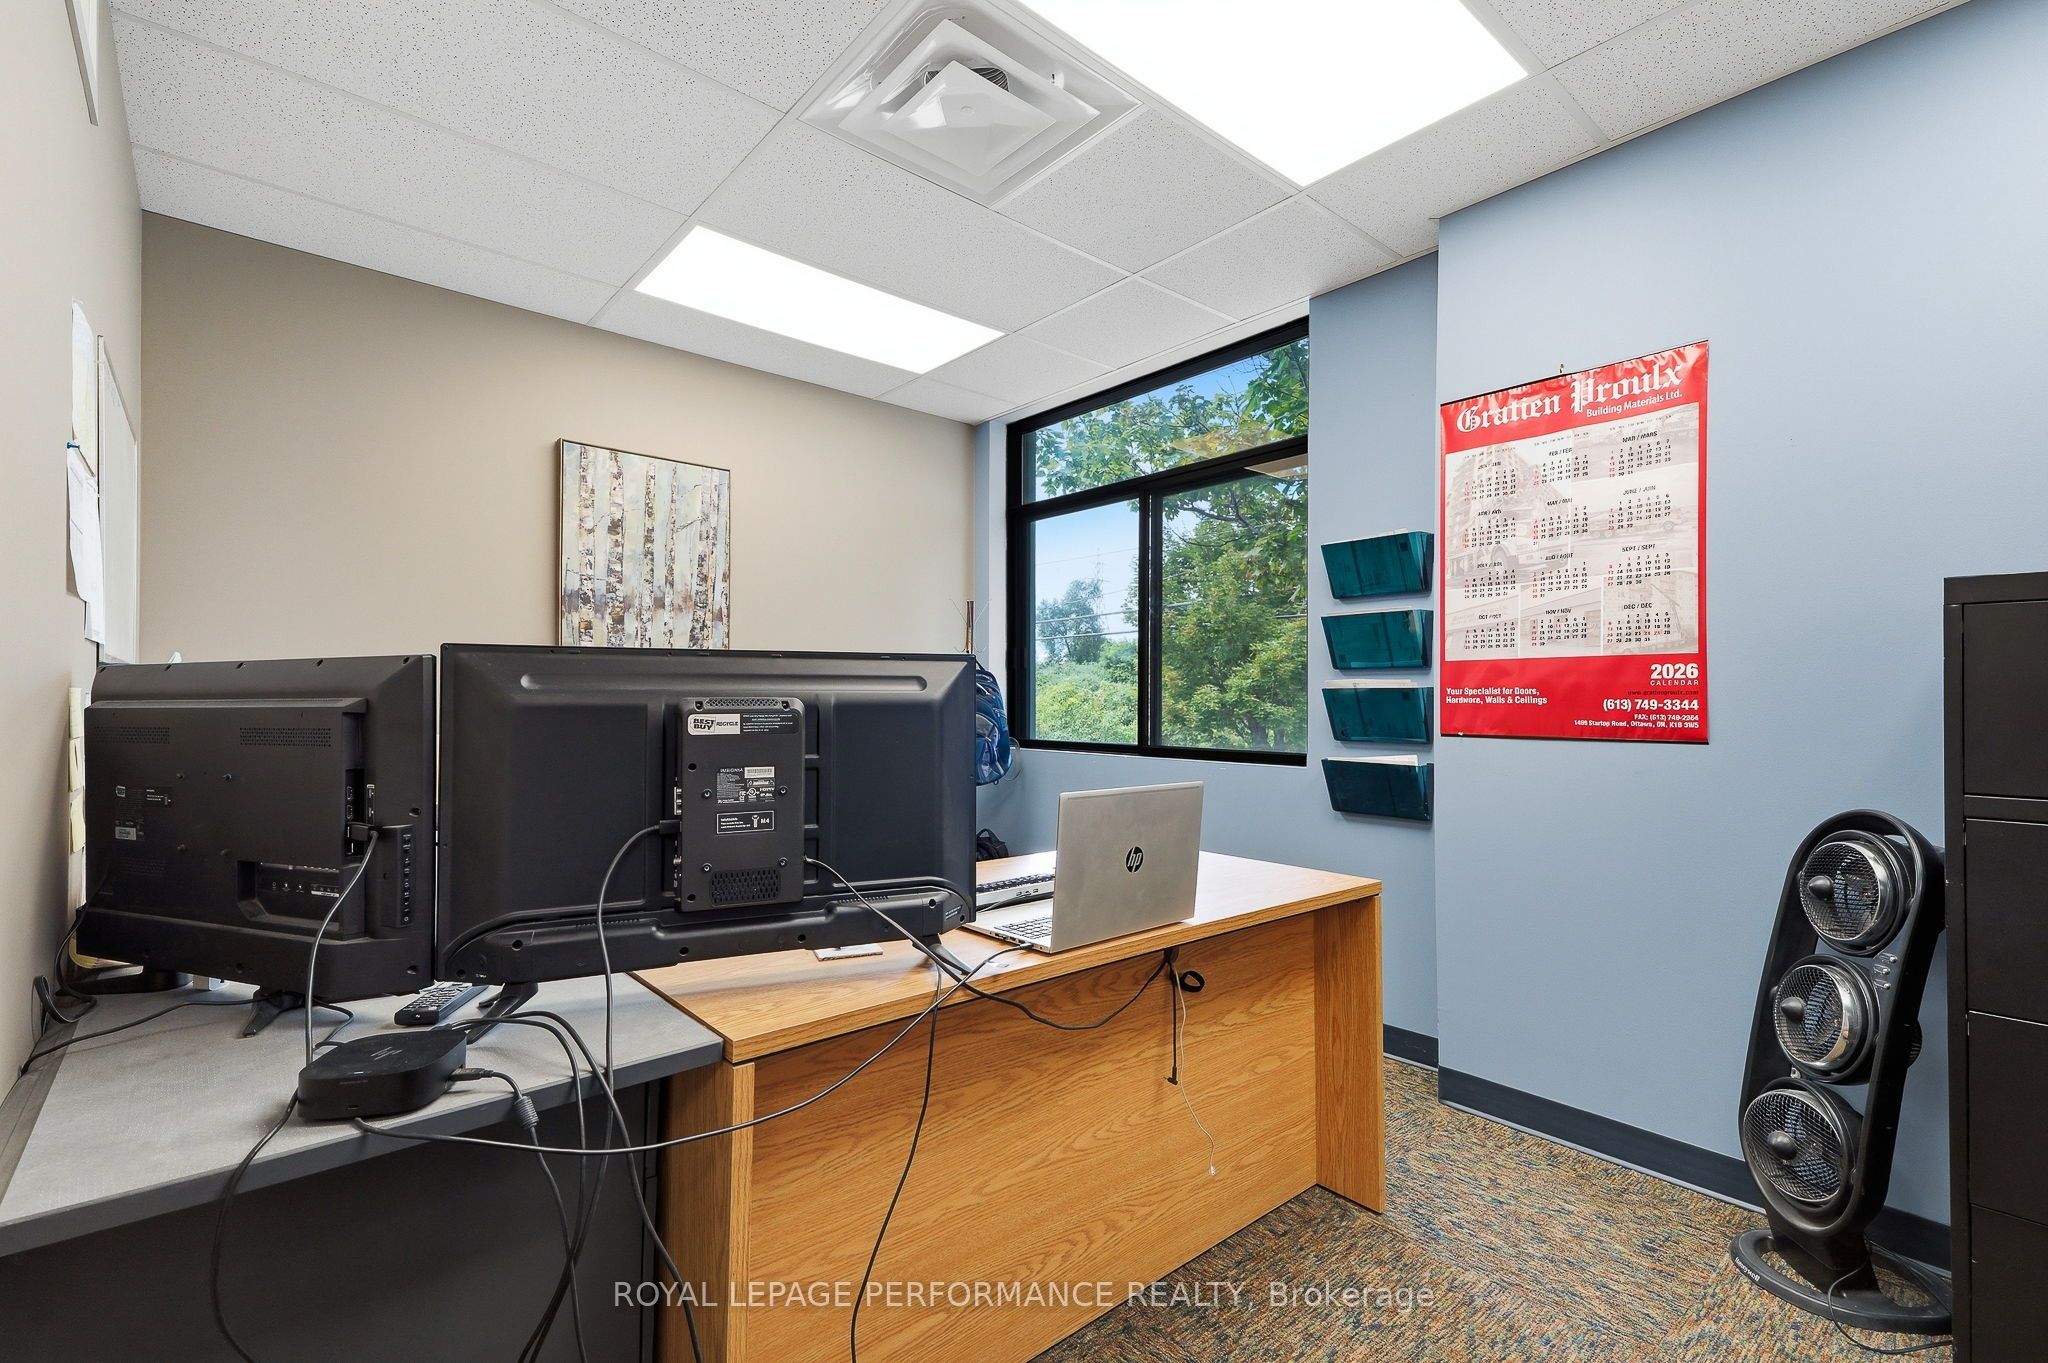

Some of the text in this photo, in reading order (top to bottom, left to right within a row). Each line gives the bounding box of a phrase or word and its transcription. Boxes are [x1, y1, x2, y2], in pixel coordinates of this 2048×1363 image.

[1570, 361, 1684, 413] Proulx
[1586, 388, 1683, 418] Building Materials Ltd.
[1650, 663, 1699, 679] 2026
[1464, 687, 1500, 696] Specialist
[1514, 687, 1540, 696] Doors,
[1514, 696, 1548, 705] Ceilings
[1603, 698, 1699, 712] (613) 749-3344
[1127, 847, 1142, 873] hp
